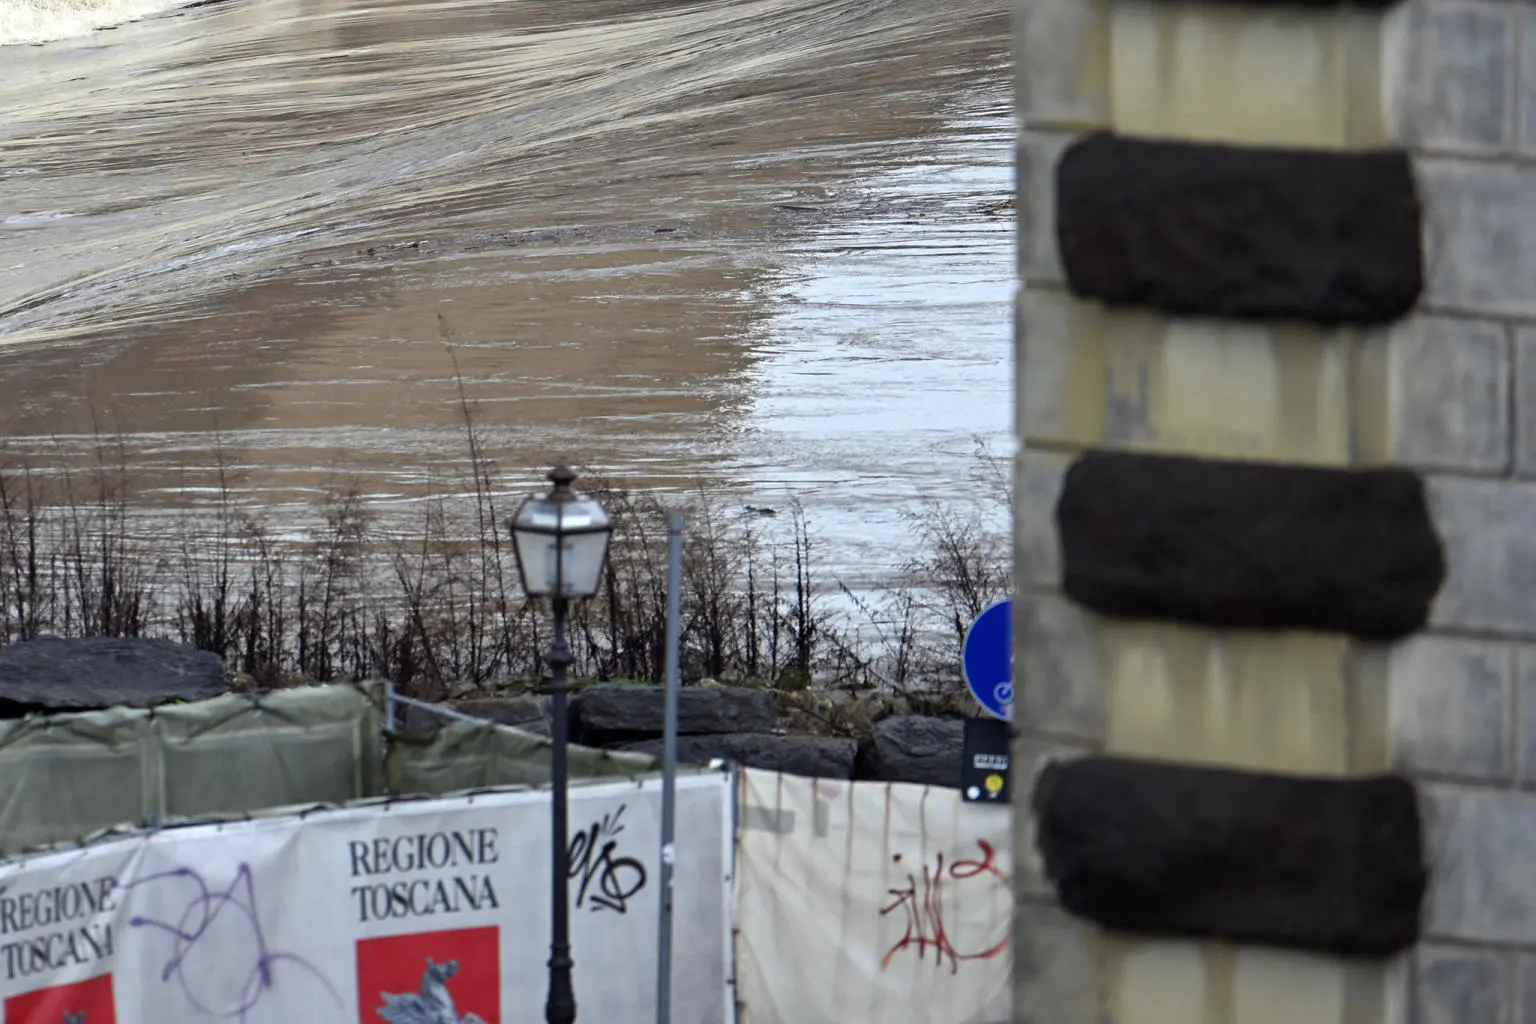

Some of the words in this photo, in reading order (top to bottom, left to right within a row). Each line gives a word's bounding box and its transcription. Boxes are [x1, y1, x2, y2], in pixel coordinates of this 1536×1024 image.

[347, 827, 499, 877] REGIONE
[0, 876, 117, 935] REGIONE
[350, 874, 500, 922] TOSCANA
[0, 923, 114, 980] TOSCANA
